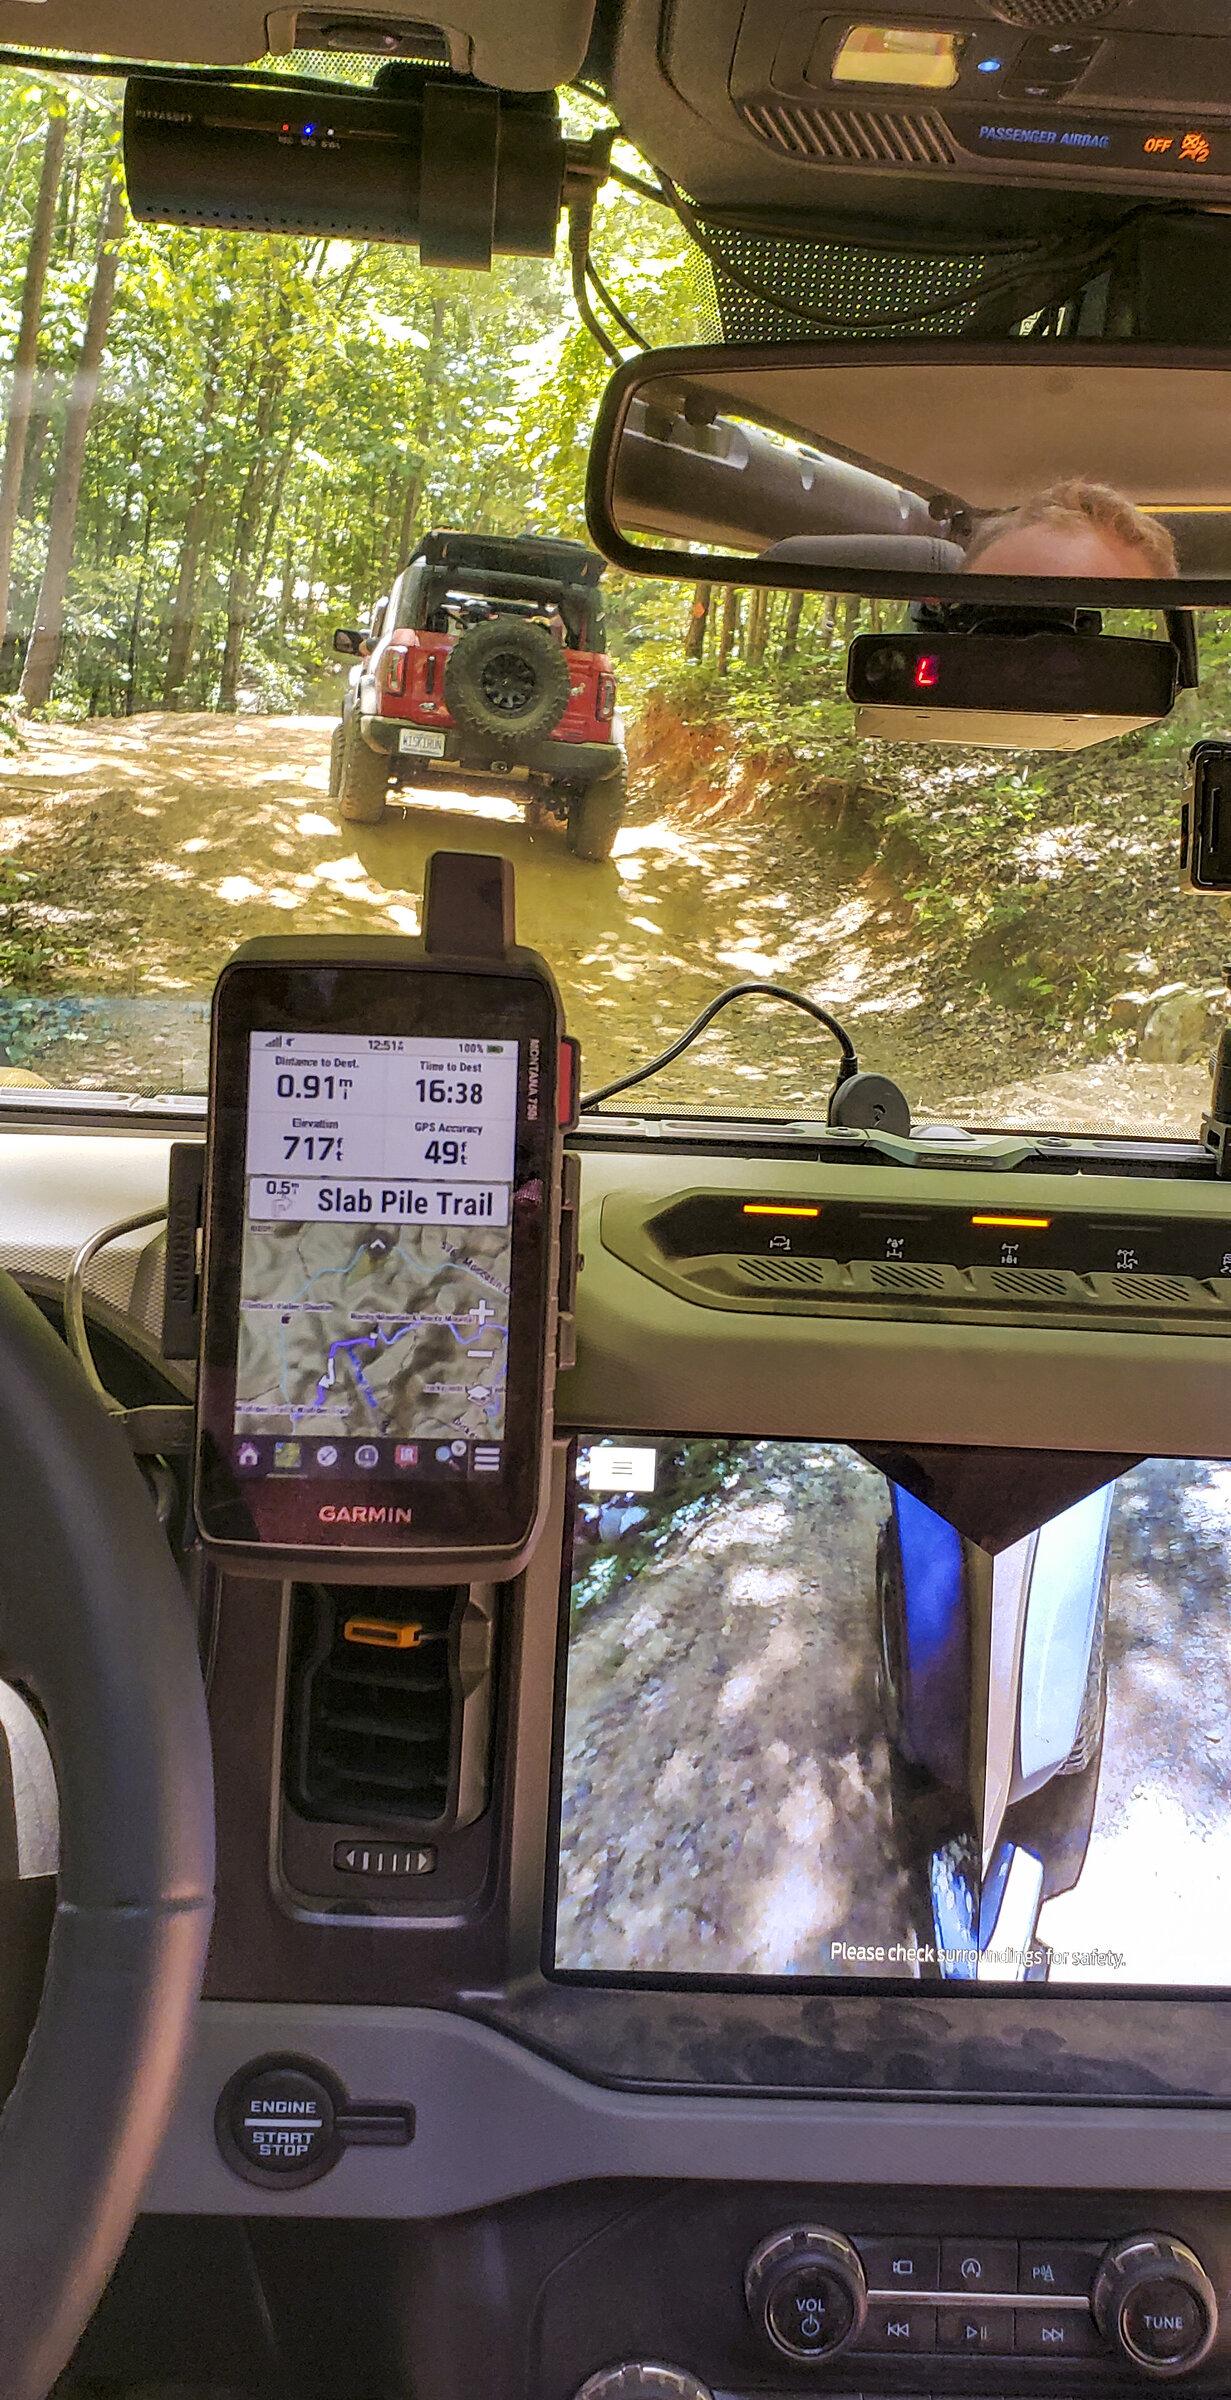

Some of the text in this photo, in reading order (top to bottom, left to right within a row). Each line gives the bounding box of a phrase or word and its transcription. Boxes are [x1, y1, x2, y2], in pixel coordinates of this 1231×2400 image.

[979, 126, 1111, 149] PASSENGER AIRBAG
[1143, 136, 1174, 154] OFF
[917, 656, 938, 686] L
[458, 1043, 484, 1054] 100%
[275, 1056, 318, 1067] Distance
[321, 1058, 332, 1067] to
[420, 1061, 482, 1072] Time to Dest
[527, 1039, 540, 1096] MONTANA
[277, 1074, 334, 1099] 0.91
[415, 1079, 483, 1105] 16:38
[292, 1117, 339, 1129] Elevation
[414, 1122, 483, 1135] GPS Accuracy
[283, 1136, 335, 1161] 717
[424, 1140, 459, 1164] 49
[265, 1180, 290, 1195] 0.5
[318, 1187, 493, 1216] Slab Pile Trail
[318, 1505, 413, 1524] GARMIN
[831, 1942, 1127, 1970] Please check surroundings for safety.
[250, 2100, 317, 2114] ENGINE
[252, 2131, 315, 2145] START
[258, 2144, 309, 2157] STOP
[795, 2299, 826, 2314] VOL
[1143, 2315, 1184, 2331] TUNE
